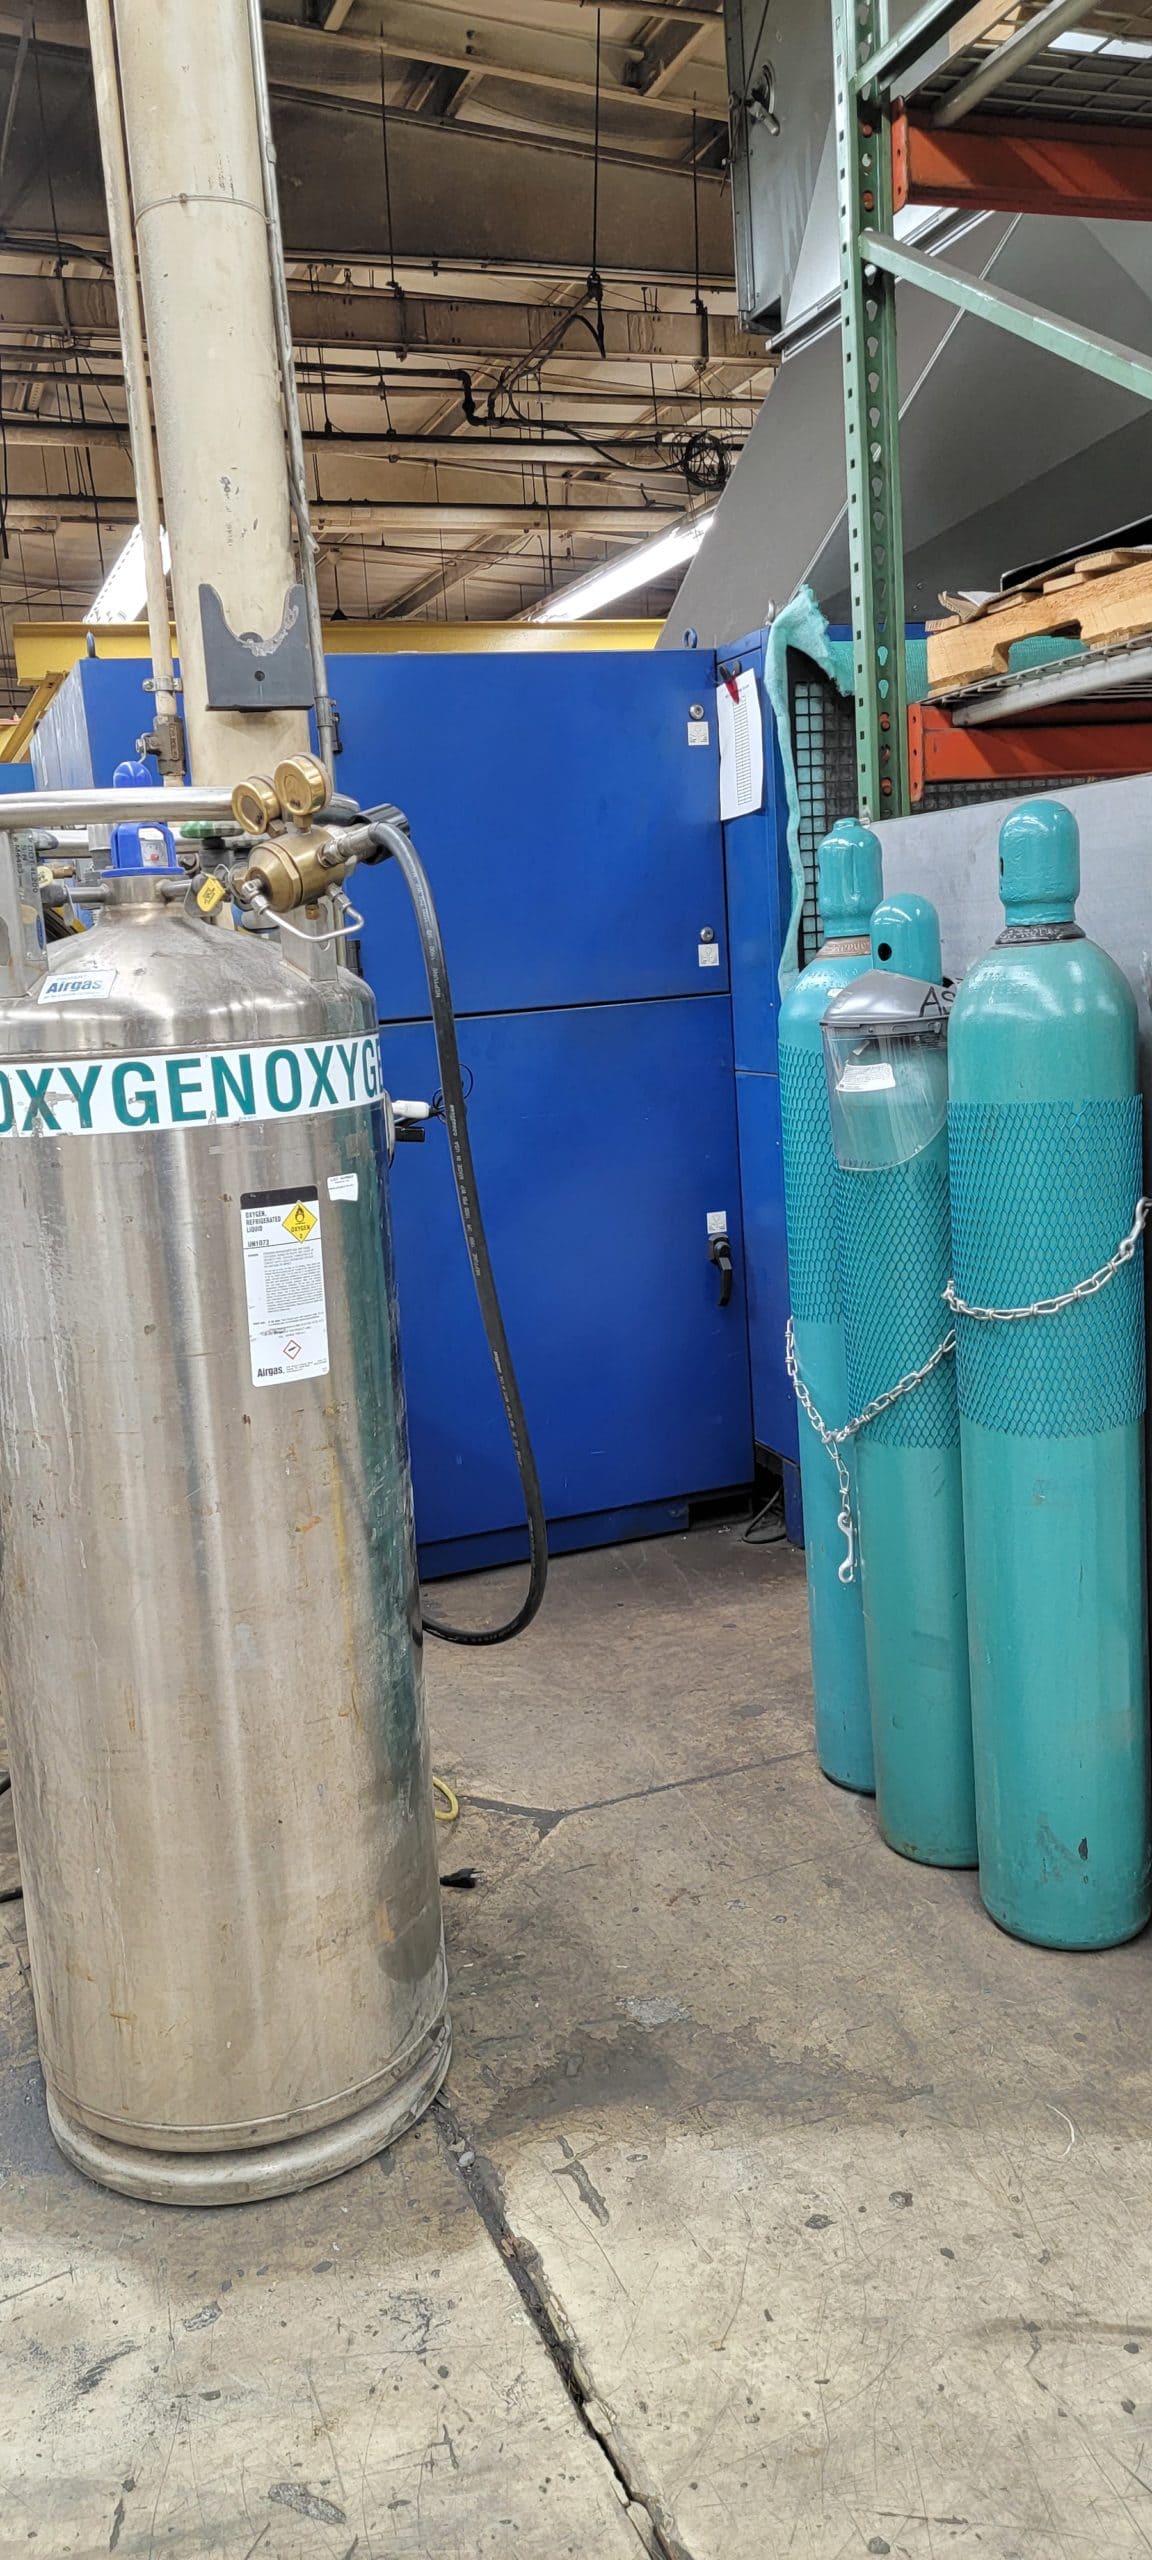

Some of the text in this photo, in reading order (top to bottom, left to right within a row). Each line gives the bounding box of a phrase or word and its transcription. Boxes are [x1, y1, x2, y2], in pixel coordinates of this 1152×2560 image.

[46, 980, 102, 994] Airgas
[246, 1216, 282, 1226] REFRIGERATED
[246, 1225, 263, 1233] LIQUID
[290, 1225, 310, 1233] OXYGEN
